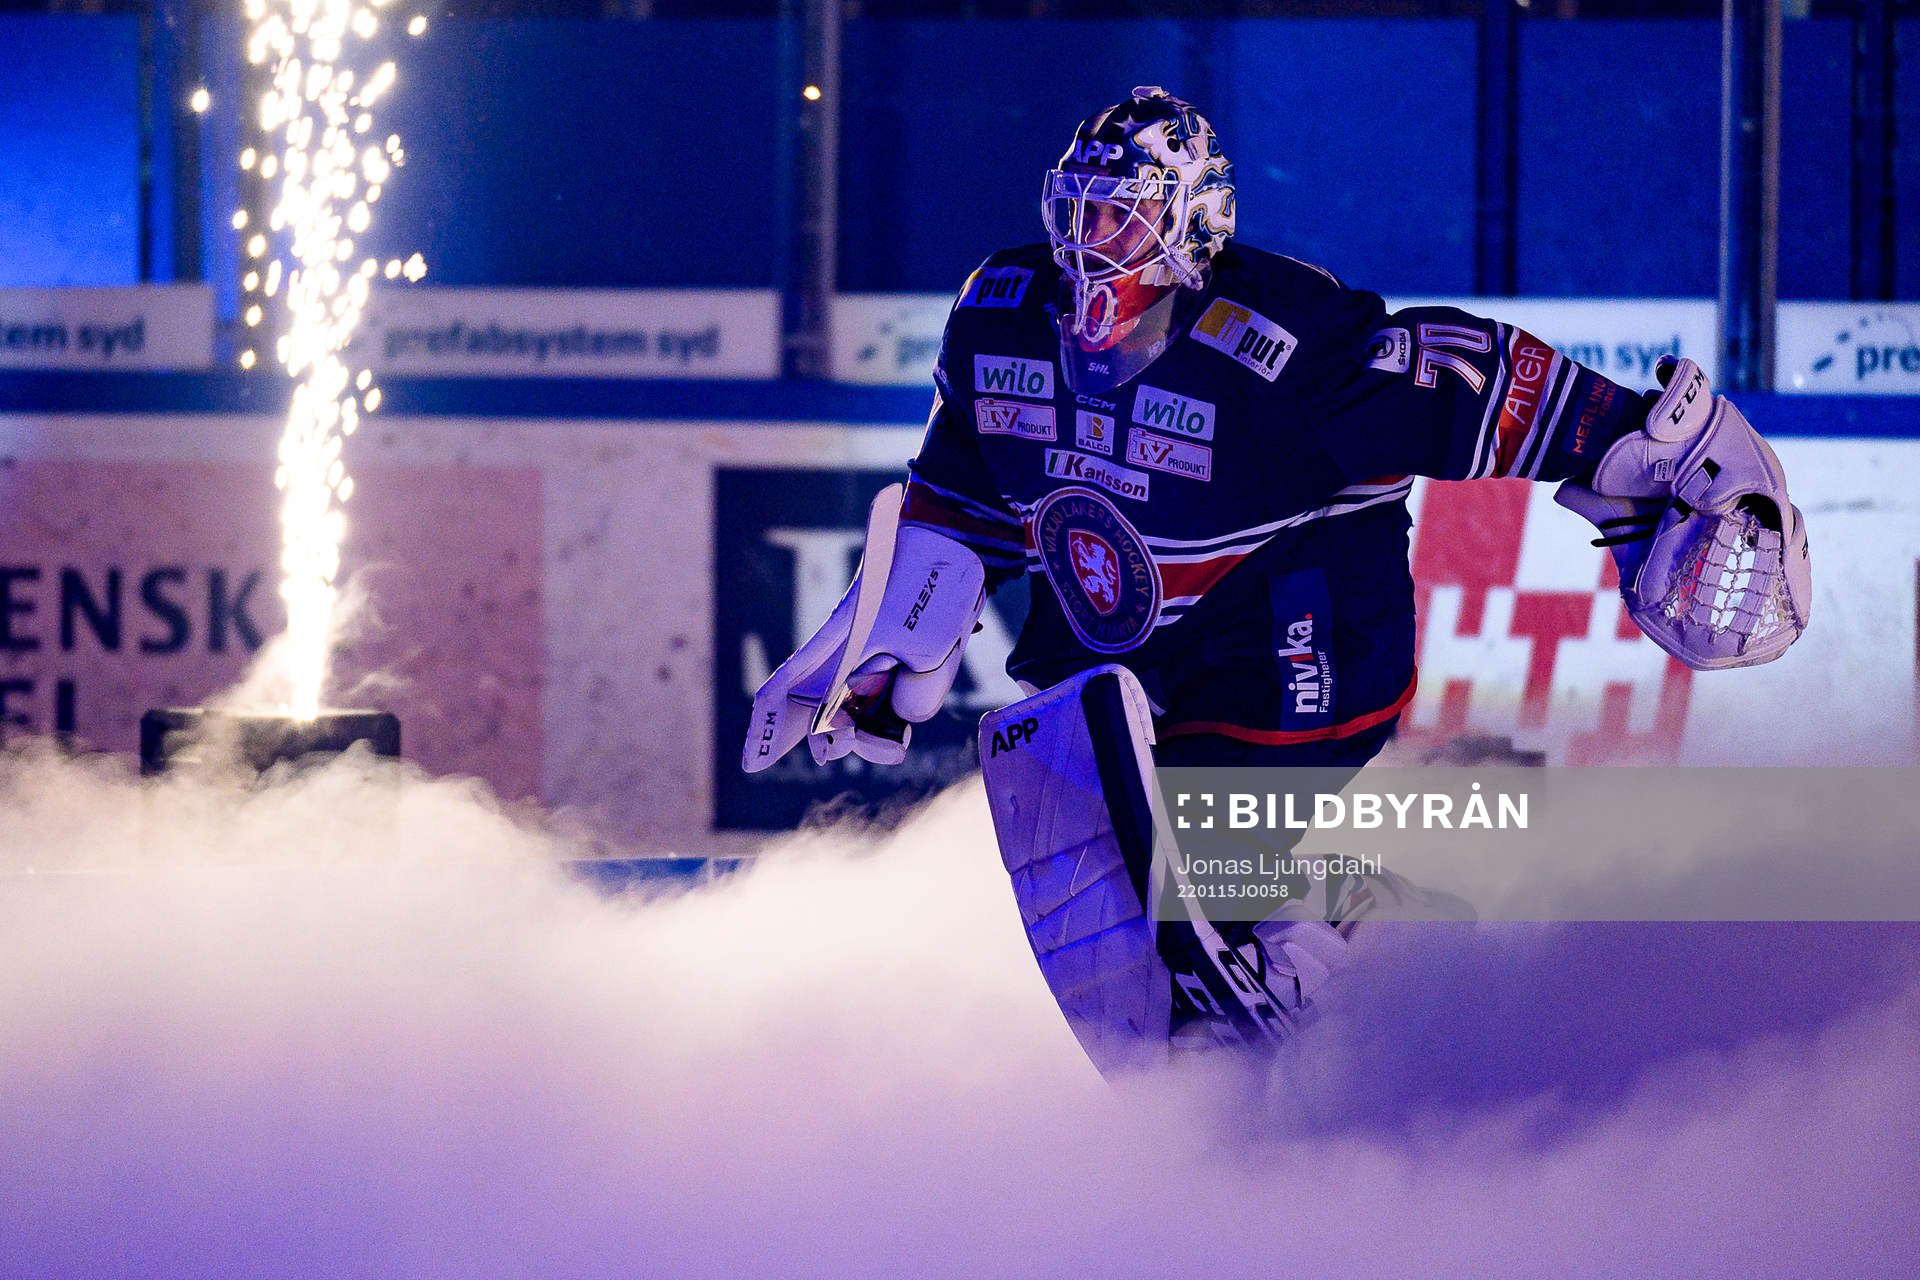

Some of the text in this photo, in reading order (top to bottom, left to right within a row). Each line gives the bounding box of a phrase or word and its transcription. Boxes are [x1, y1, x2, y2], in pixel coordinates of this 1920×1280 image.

[1072, 139, 1123, 165] APP
[983, 361, 1045, 394] wilo
[1414, 322, 1492, 395] 70
[1075, 394, 1117, 411] CCM
[1506, 346, 1549, 425] ATEA
[980, 404, 1052, 436] IV PRODUKT
[1142, 398, 1205, 434] wilo
[1078, 438, 1111, 453] BALCO
[1131, 434, 1206, 476] IV PRODUKT
[1063, 454, 1147, 498] Karlsson
[1114, 527, 1150, 598] HOCKEY
[1318, 650, 1333, 713] Fastigheter
[758, 711, 777, 758] CCM
[990, 717, 1039, 759] APP
